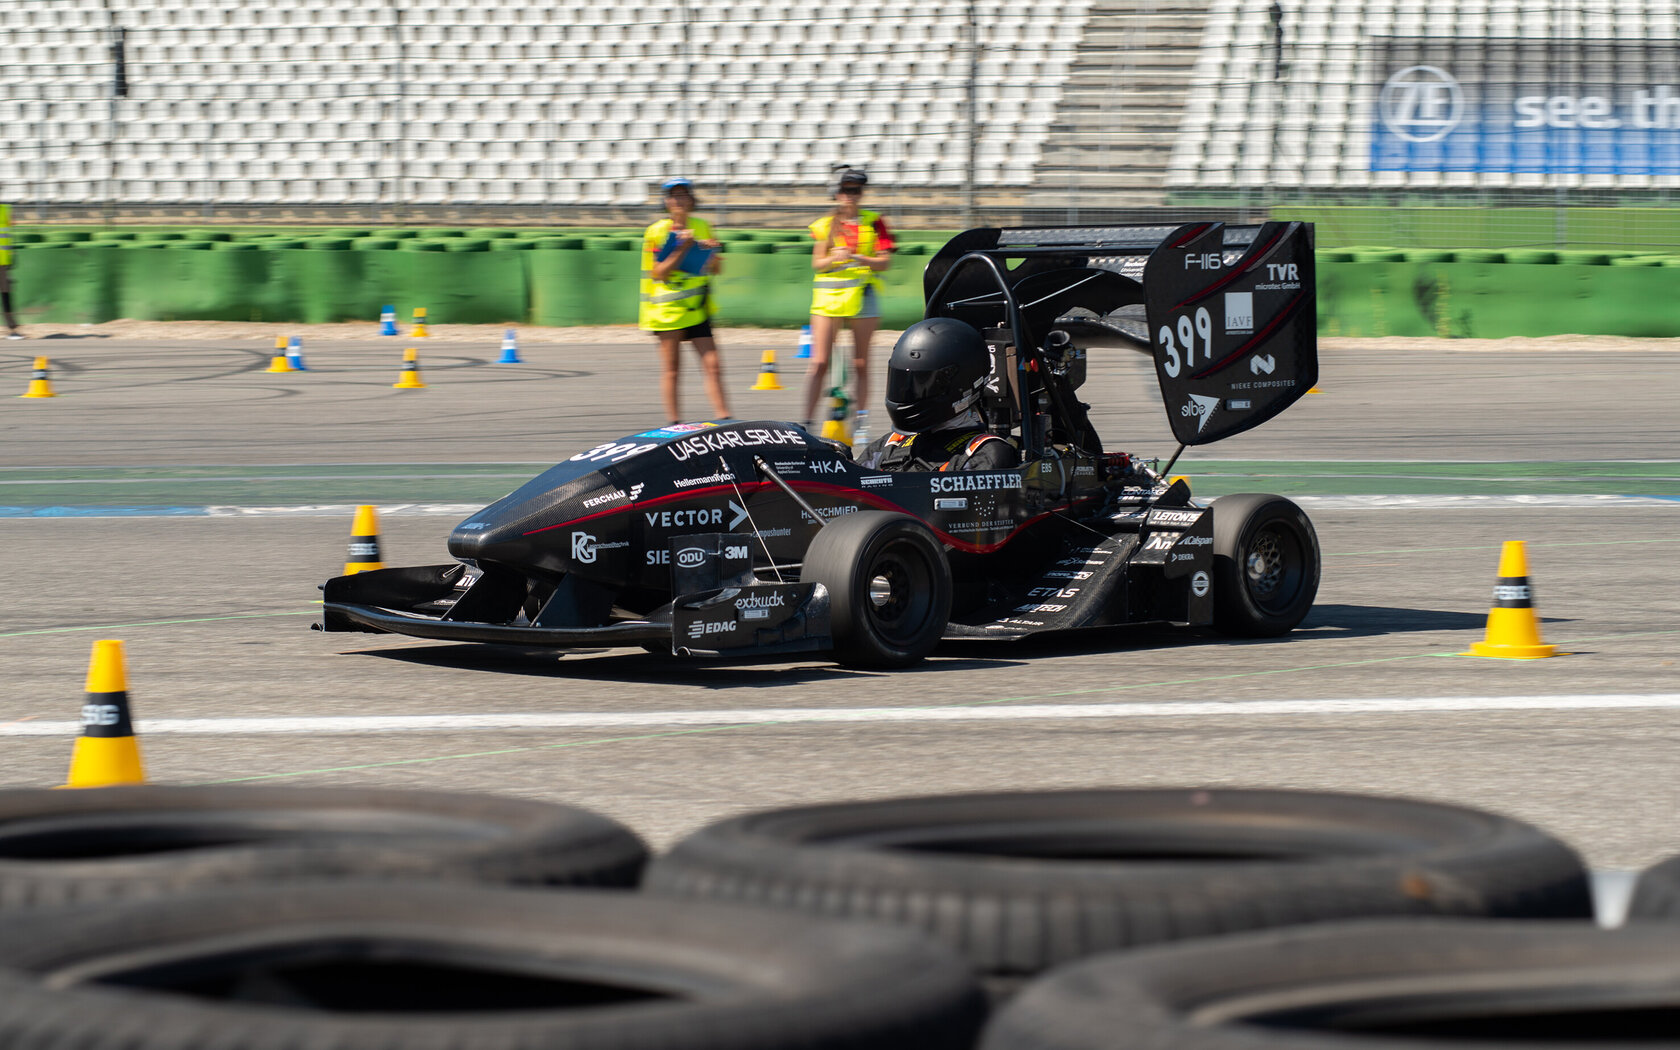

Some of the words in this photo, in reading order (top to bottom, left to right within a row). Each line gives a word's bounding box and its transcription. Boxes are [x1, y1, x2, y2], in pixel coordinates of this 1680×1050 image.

[1255, 283, 1281, 291] microtec
[1282, 282, 1301, 290] GmbH
[1226, 316, 1253, 328] IAVF
[1159, 306, 1212, 378] 399
[1231, 380, 1251, 390] NIEKE
[1253, 379, 1296, 389] COMPOSITES
[667, 437, 708, 461] UAS
[706, 428, 807, 451] KARLSRUHE
[570, 442, 659, 462] 399
[809, 460, 847, 473] HKA
[673, 472, 736, 489] HellermannTyton
[930, 474, 1022, 493] SCHAEFFLER
[582, 489, 627, 509] FERCHAU
[645, 508, 723, 527] VECTOR
[948, 521, 980, 529] VERBUND
[679, 551, 704, 564] ODU
[724, 546, 748, 560] 3M
[734, 590, 785, 609] extrudr
[1027, 587, 1080, 598] ETAS
[705, 620, 737, 633] EDAG
